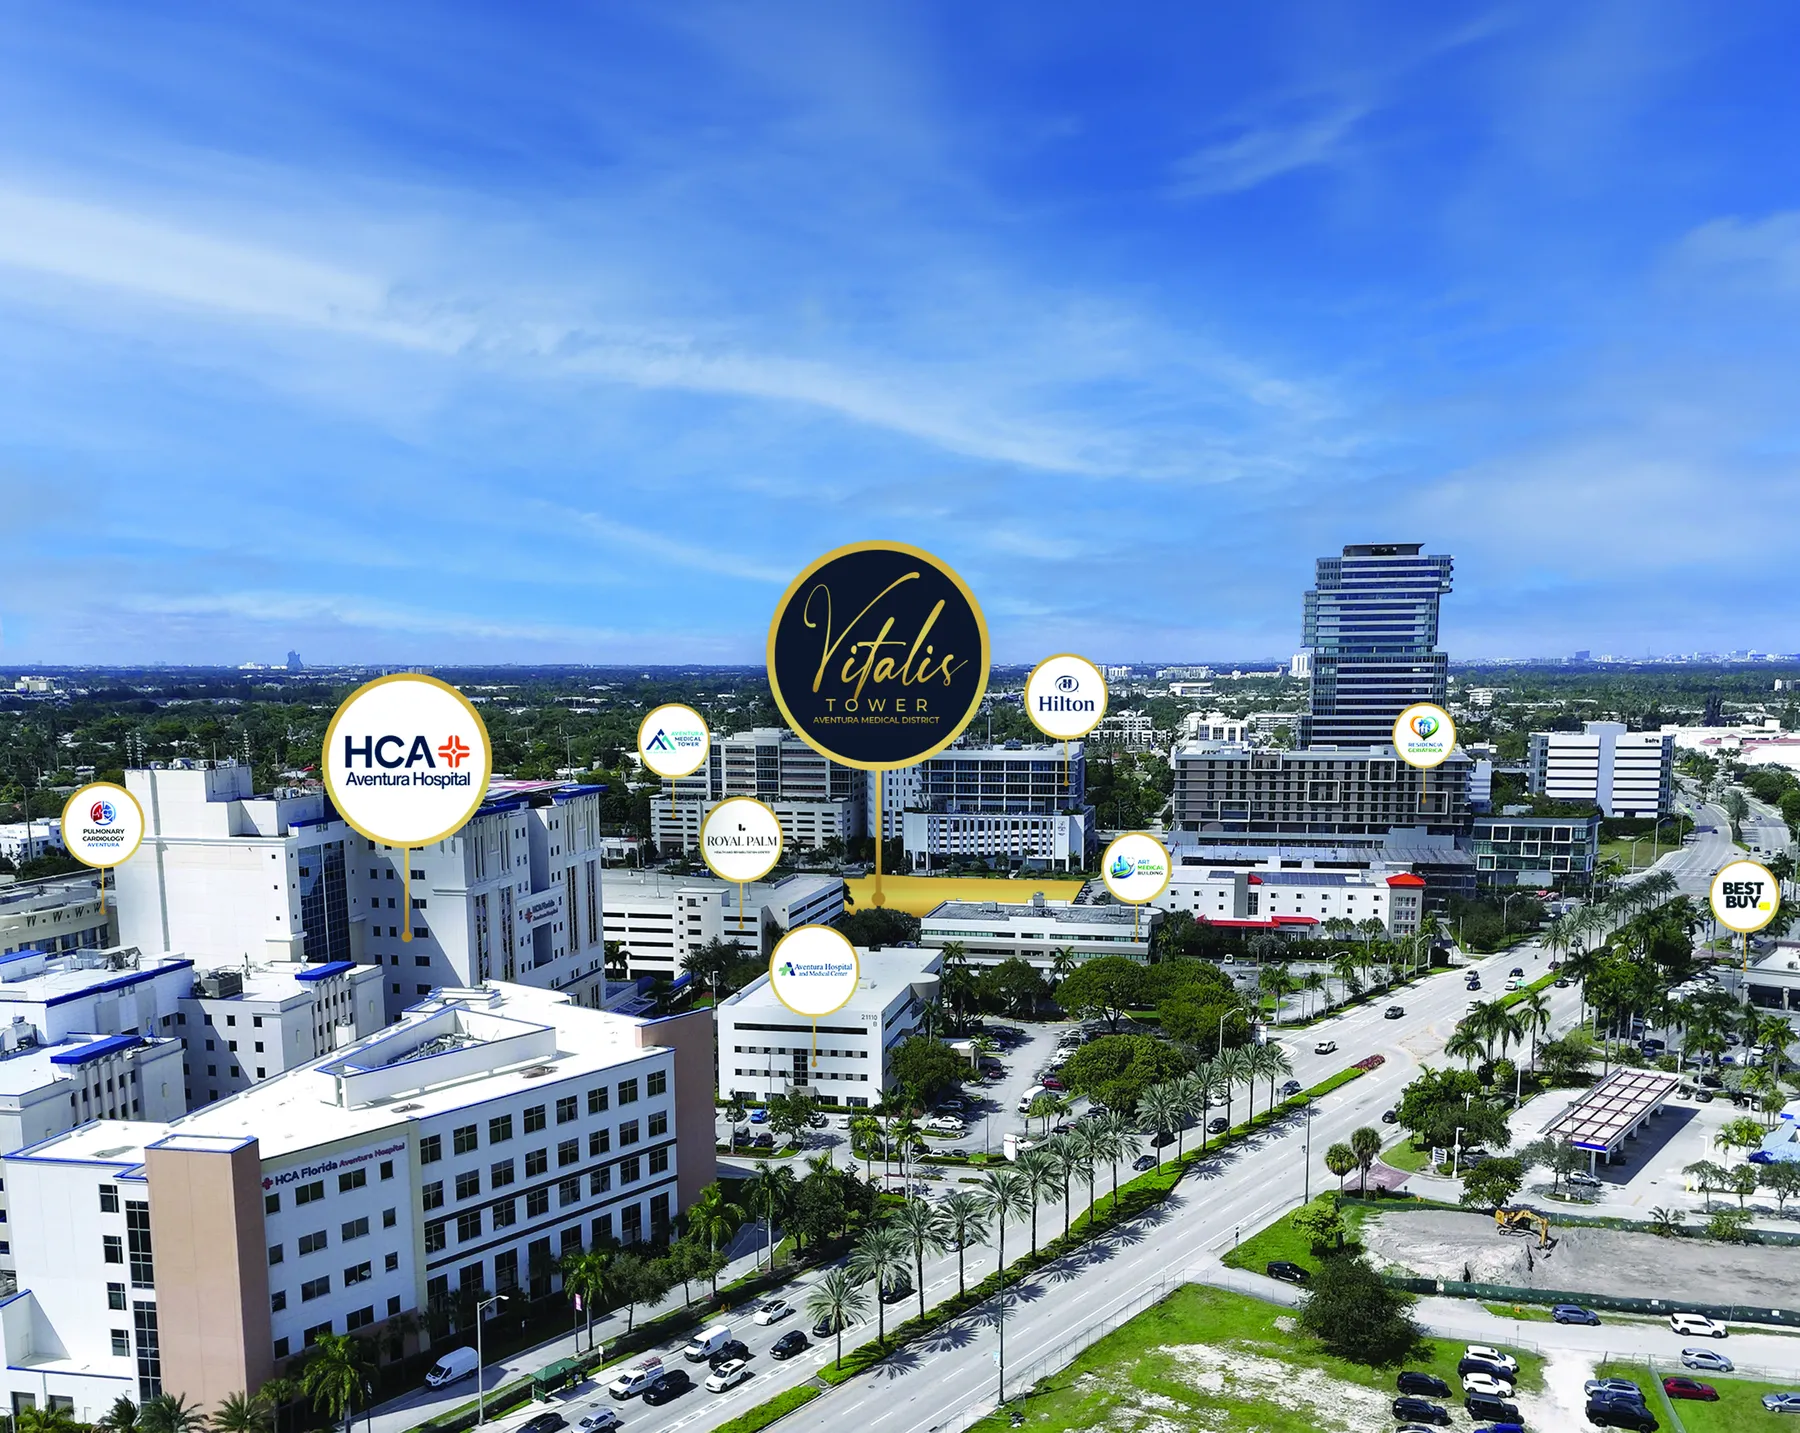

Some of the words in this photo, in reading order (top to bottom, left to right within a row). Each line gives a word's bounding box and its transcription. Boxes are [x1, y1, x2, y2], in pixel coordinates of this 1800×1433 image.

[275, 1171, 300, 1185] HCA
[301, 1161, 338, 1178] Florida
[339, 1152, 373, 1168] Aventura
[374, 1142, 405, 1157] Hospital
